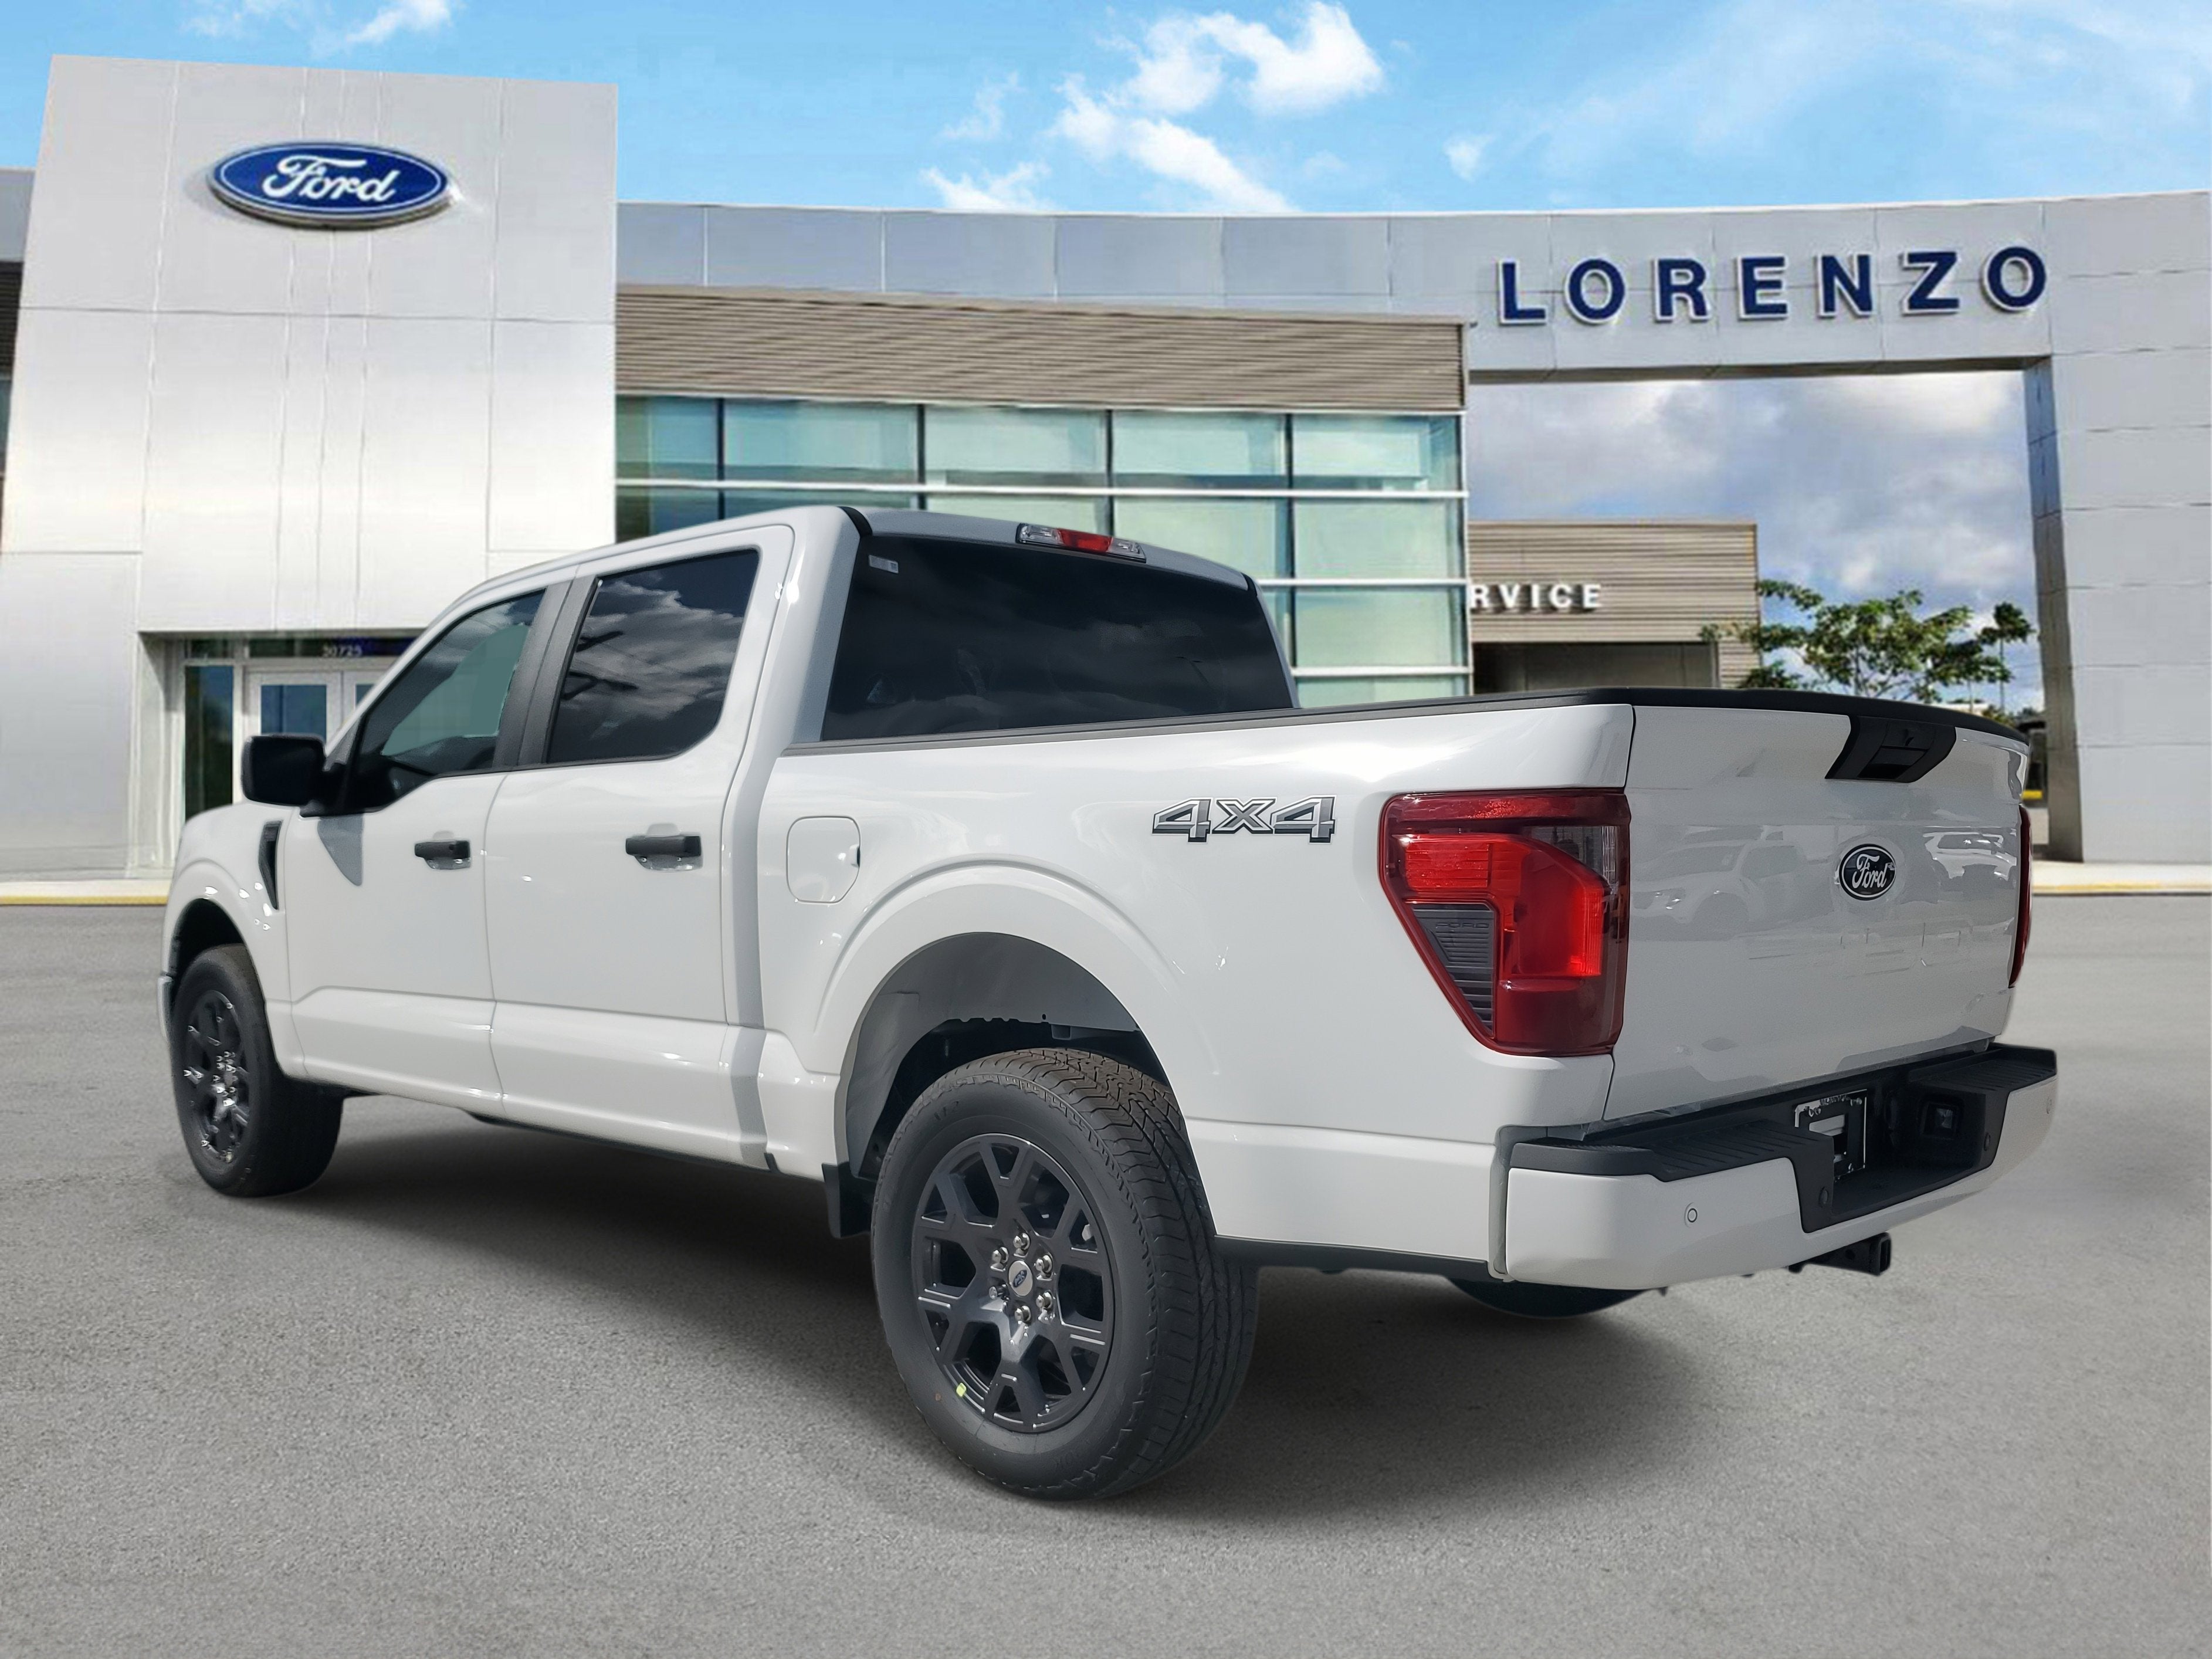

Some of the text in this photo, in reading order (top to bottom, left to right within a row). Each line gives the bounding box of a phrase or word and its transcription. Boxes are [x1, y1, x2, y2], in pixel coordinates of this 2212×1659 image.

[263, 155, 400, 203] Ford
[1497, 246, 2047, 326] LORENZO
[1470, 584, 1602, 608] RVICE
[1852, 854, 1888, 888] Ford
